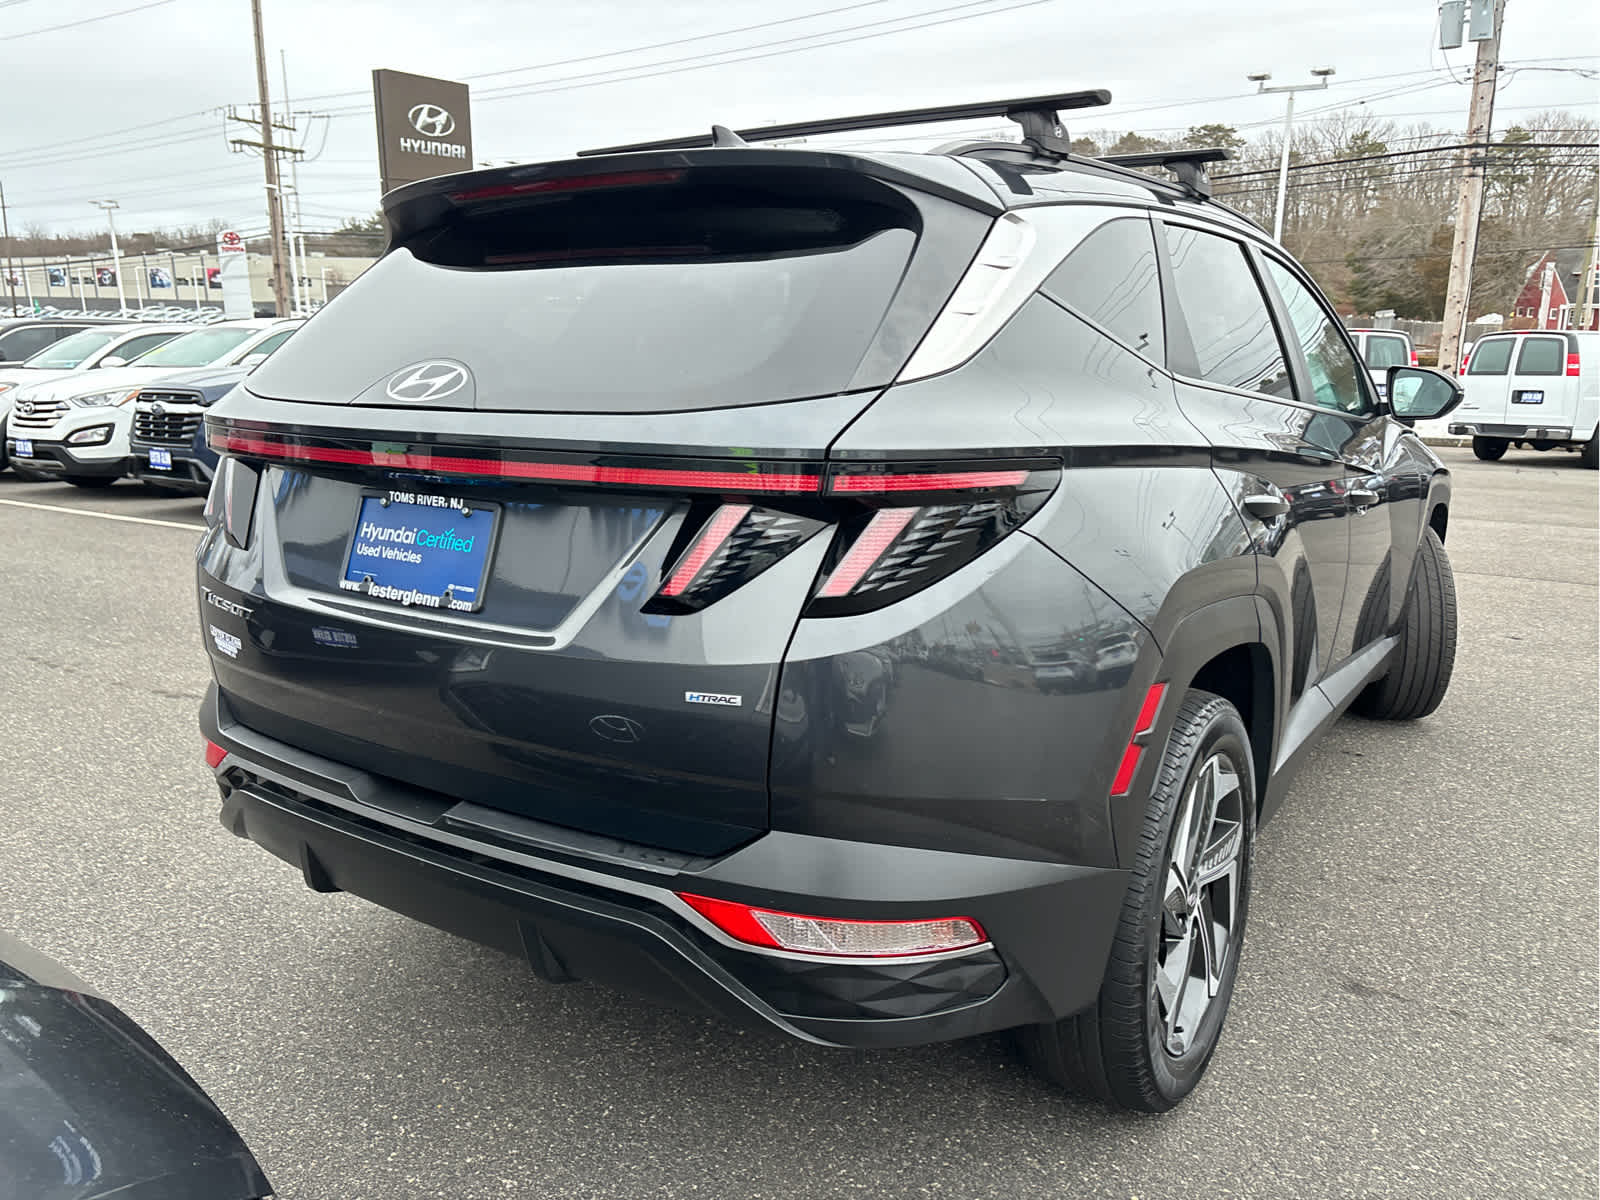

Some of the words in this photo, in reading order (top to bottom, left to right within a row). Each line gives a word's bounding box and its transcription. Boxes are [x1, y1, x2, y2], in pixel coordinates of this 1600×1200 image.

[400, 137, 466, 159] HYUNDAI
[389, 491, 415, 504] TOMS
[417, 494, 448, 508] RIVER,
[450, 497, 464, 510] NJ
[360, 521, 418, 545] Hyundai
[416, 528, 475, 553] Certified
[356, 543, 381, 558] Used
[382, 546, 423, 564] Vehicles
[367, 581, 440, 607] lesterglenn
[447, 600, 473, 612] .com
[688, 694, 737, 704] HTRAC
